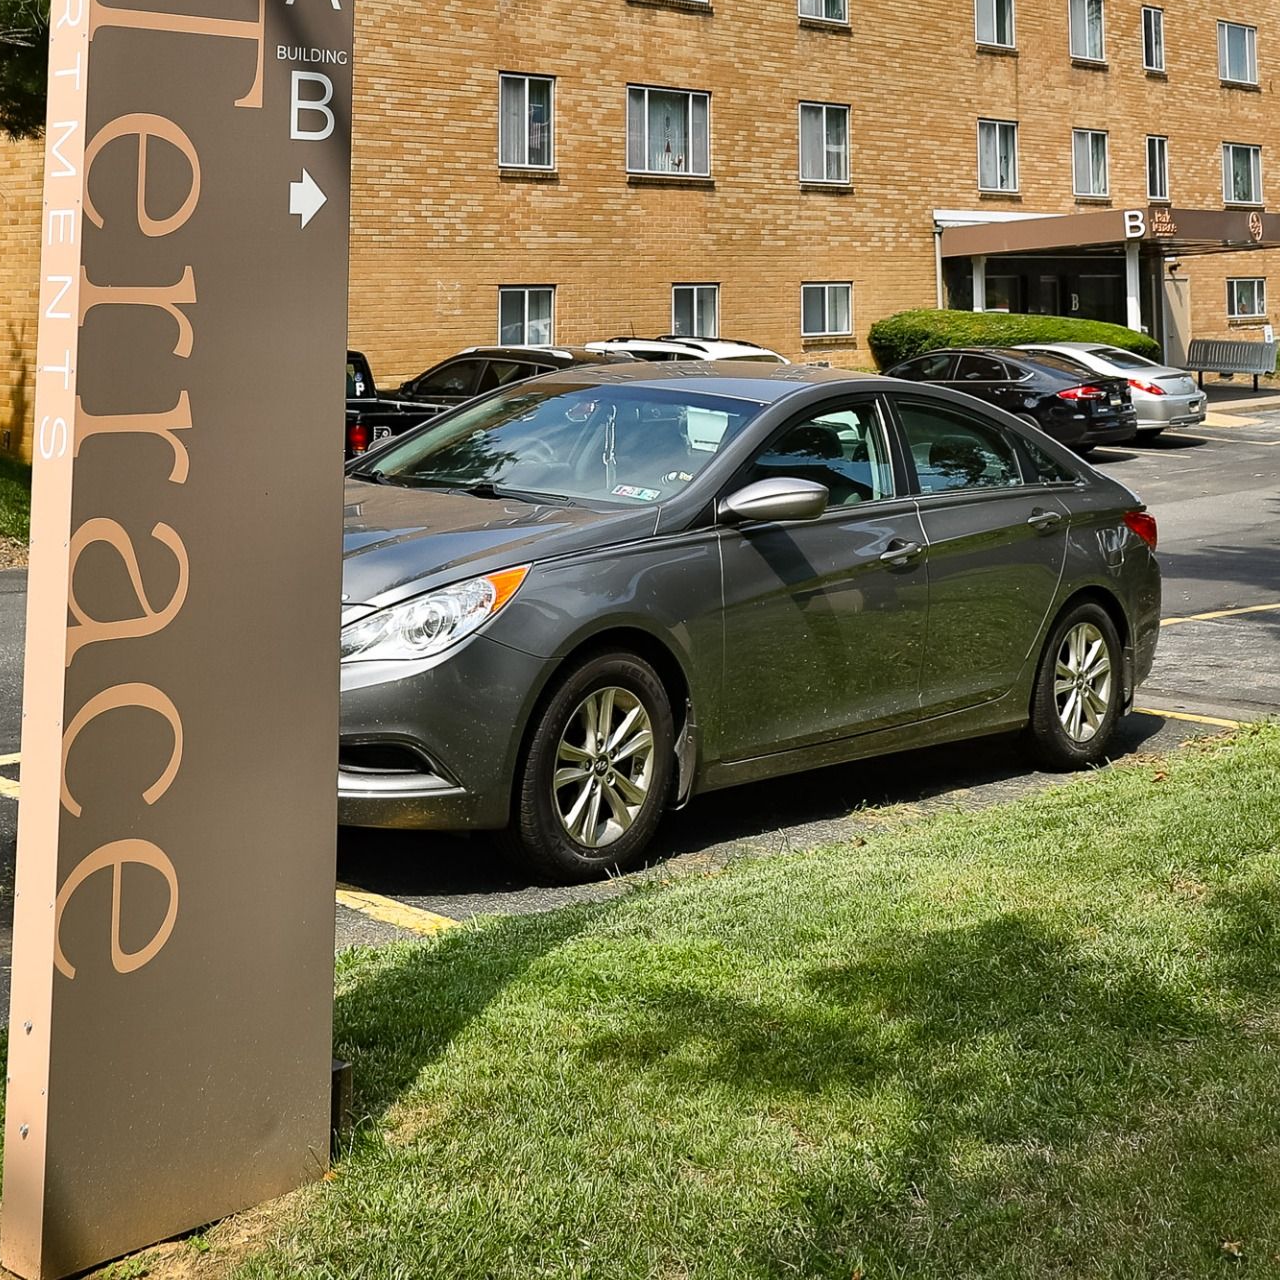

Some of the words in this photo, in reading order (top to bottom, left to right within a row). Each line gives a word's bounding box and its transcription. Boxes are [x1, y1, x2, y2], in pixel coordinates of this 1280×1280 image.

[277, 45, 348, 65] BUILDING
[290, 70, 335, 141] B
[1124, 210, 1146, 238] B
[1072, 293, 1079, 311] B
